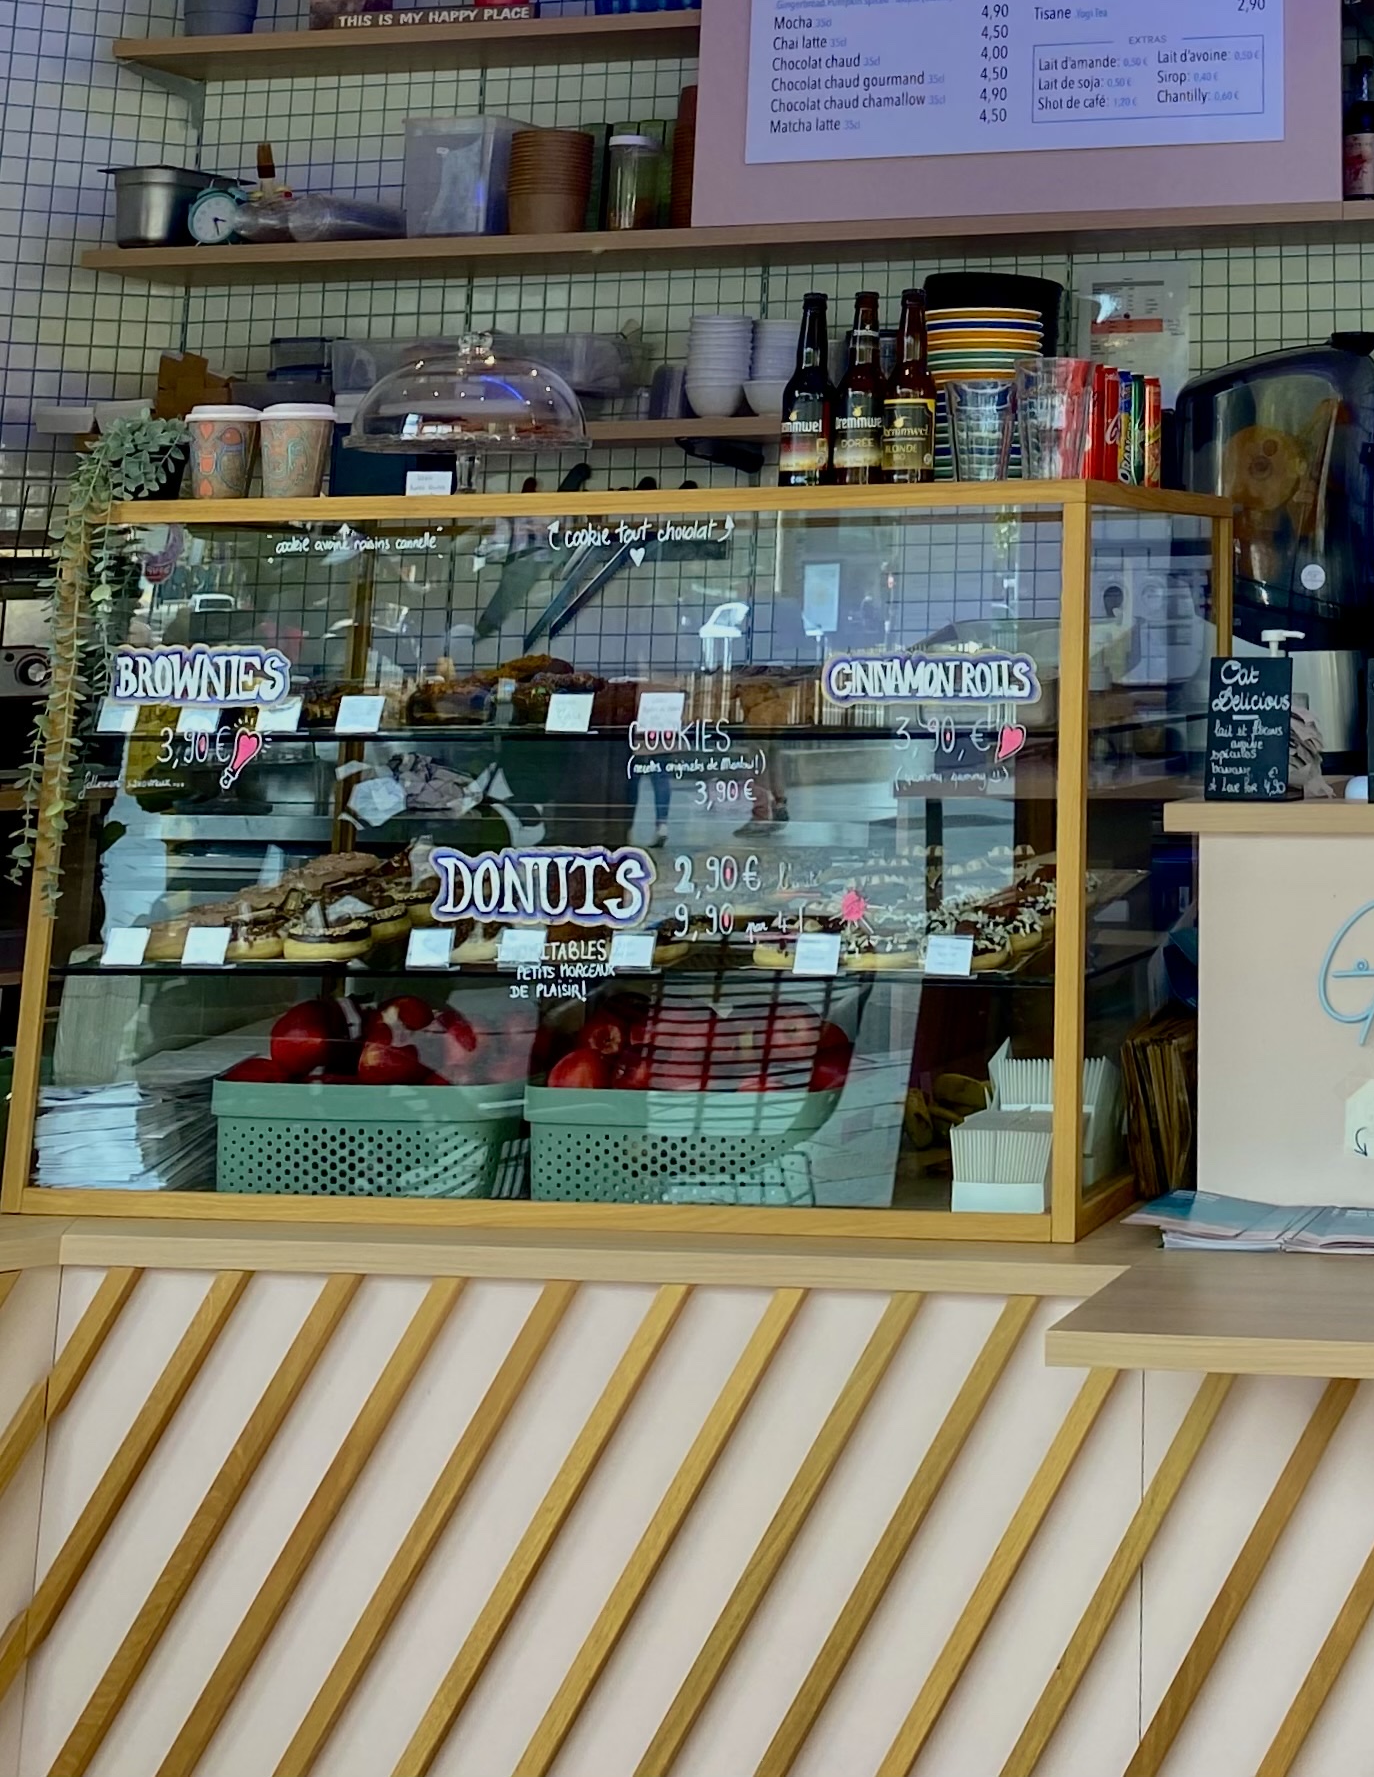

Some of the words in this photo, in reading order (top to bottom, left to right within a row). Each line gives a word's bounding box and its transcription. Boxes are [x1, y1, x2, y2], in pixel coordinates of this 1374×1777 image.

[338, 15, 372, 28] THIS
[378, 13, 394, 26] IS
[400, 11, 424, 24] MY
[428, 9, 479, 23] HAPPY
[483, 6, 530, 20] PLACE
[774, 16, 812, 29] Mocha
[1035, 7, 1071, 20] Tisane
[773, 37, 798, 50] Chai
[802, 35, 827, 49] latte
[1129, 35, 1167, 45] EXTRAS
[772, 56, 822, 71] Chocolat
[825, 54, 860, 68] chaud
[772, 76, 821, 92] Chocolat
[825, 74, 859, 89] chaud
[863, 71, 924, 91] gourmand
[771, 97, 820, 113] Chocolat
[824, 95, 859, 110] chaud
[862, 92, 925, 108] chamallow
[770, 118, 811, 133] Matcha
[816, 117, 840, 131] latte
[564, 526, 611, 548] cookie
[618, 522, 652, 544] tout
[657, 519, 717, 543] chocolat
[115, 653, 288, 702] BROWNIES
[830, 660, 956, 698] CINNAMON
[961, 663, 1031, 697] ROLLS
[1211, 686, 1290, 712] Delicious
[156, 726, 209, 769] 3,90
[216, 725, 231, 762] €
[628, 718, 731, 753] COOKIES
[970, 718, 990, 752] €
[695, 779, 739, 811] 3,90
[743, 779, 757, 801] €
[437, 855, 650, 916] DONUTS
[674, 855, 738, 900] 2,90
[742, 855, 761, 891] €
[673, 902, 734, 942] 9,90
[516, 965, 555, 981] PETITS
[560, 962, 615, 978] MORCEAUX
[509, 985, 529, 999] DE
